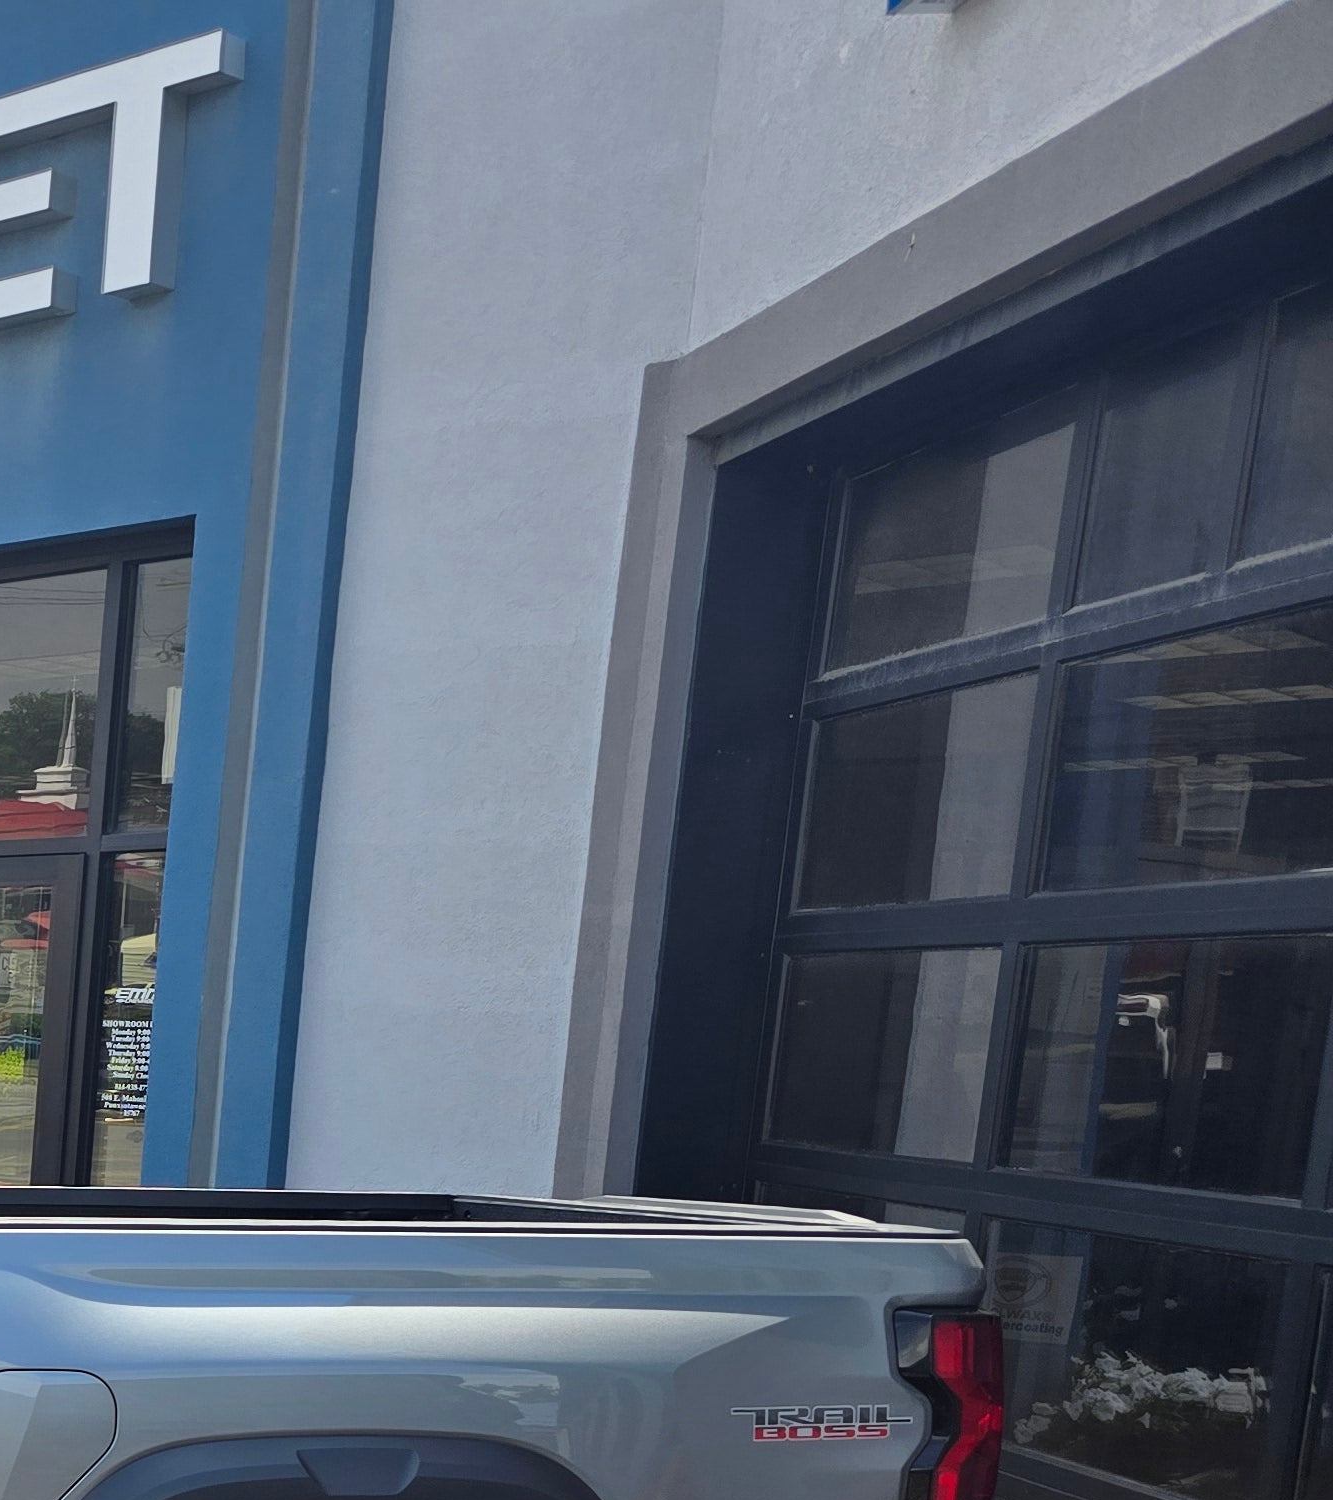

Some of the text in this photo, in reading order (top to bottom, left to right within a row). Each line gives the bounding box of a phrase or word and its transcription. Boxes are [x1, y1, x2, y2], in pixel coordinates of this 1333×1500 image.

[102, 1020, 149, 1028] SHOWROOM
[111, 1028, 136, 1036] Monday
[106, 1042, 140, 1051] Wednesday
[108, 1049, 136, 1057] Thursday
[111, 1057, 132, 1065] Friday
[107, 1064, 135, 1073] Saturday
[113, 1072, 135, 1080] Sunday
[730, 1403, 914, 1426] TRAIL
[753, 1424, 891, 1442] BOSS
